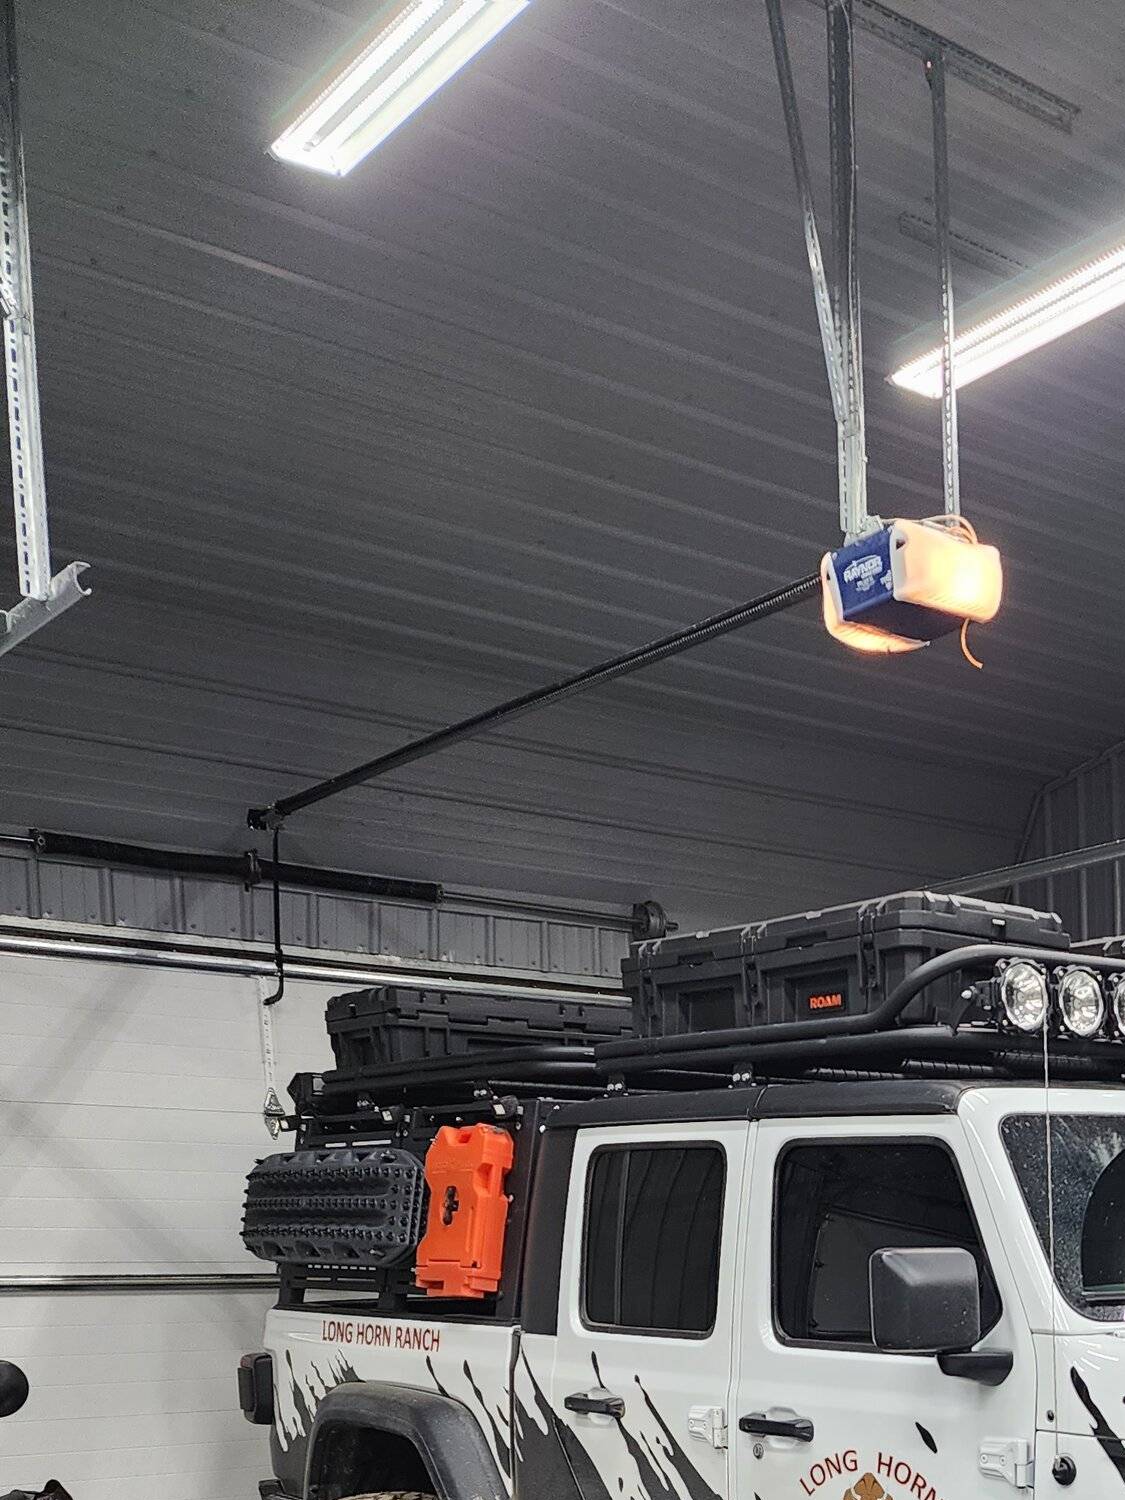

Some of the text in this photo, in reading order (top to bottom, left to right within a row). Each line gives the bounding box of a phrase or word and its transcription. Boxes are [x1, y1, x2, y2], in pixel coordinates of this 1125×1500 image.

[809, 993, 841, 1009] ROAM
[322, 1320, 440, 1352] LONG HORN RANCH
[799, 1450, 858, 1496] LONG
